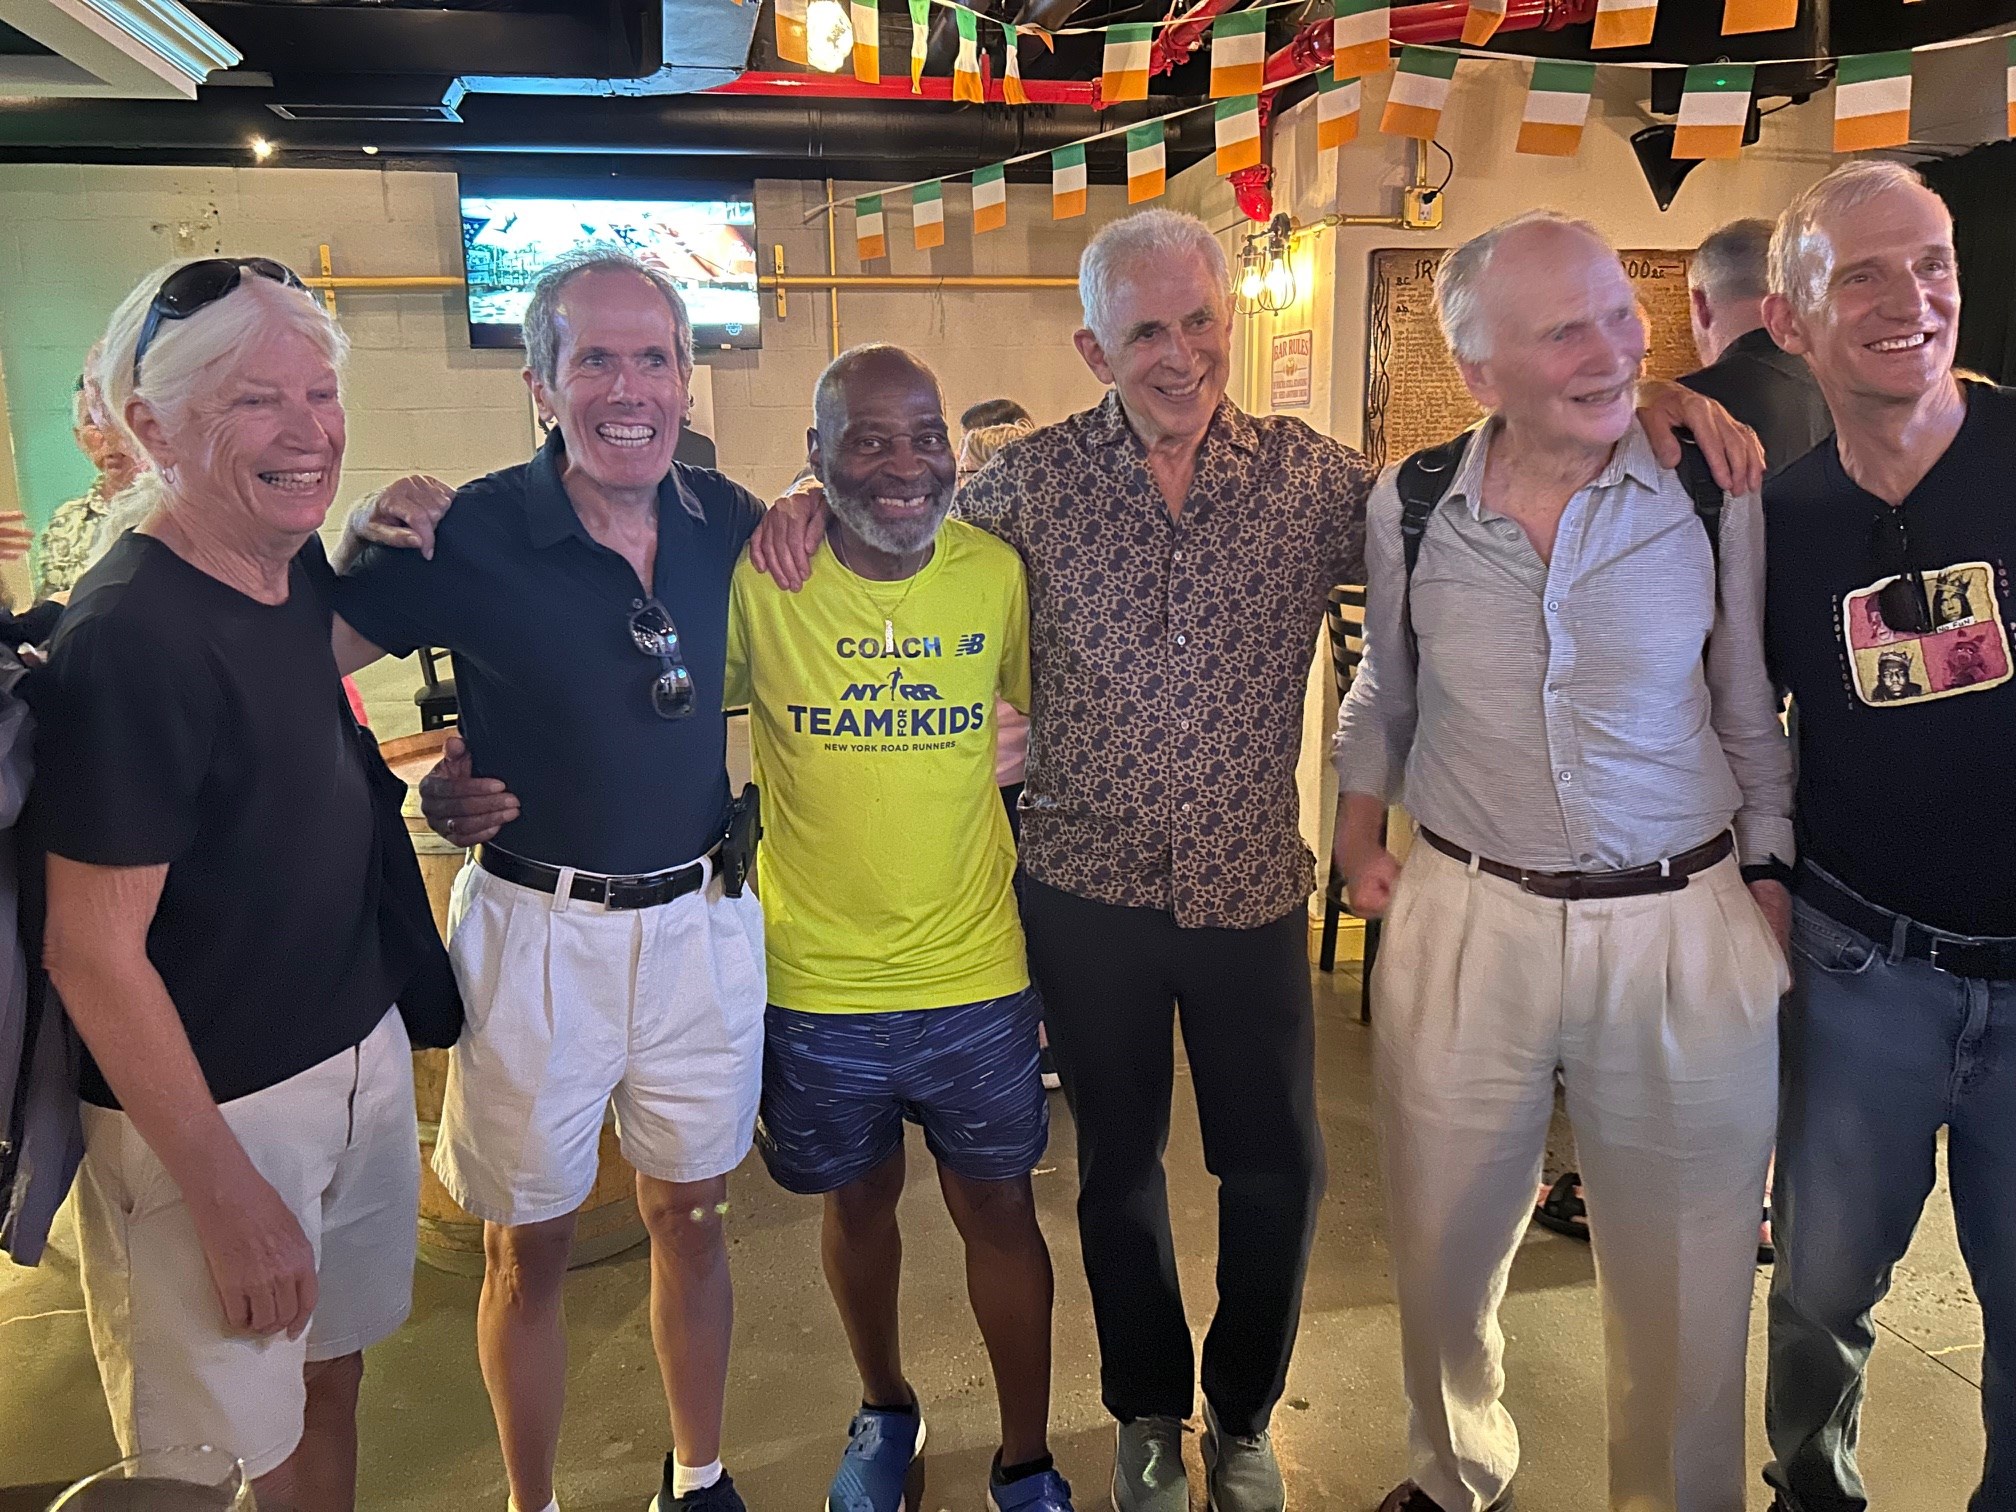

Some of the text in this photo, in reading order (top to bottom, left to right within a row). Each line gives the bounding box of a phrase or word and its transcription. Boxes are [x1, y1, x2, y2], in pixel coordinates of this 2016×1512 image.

[1273, 338, 1309, 361] BAR RULES
[836, 636, 943, 659] COACH
[787, 702, 984, 738] TEAM FOR KIDS
[824, 740, 957, 753] NEW YORK ROAD RUNNERS
